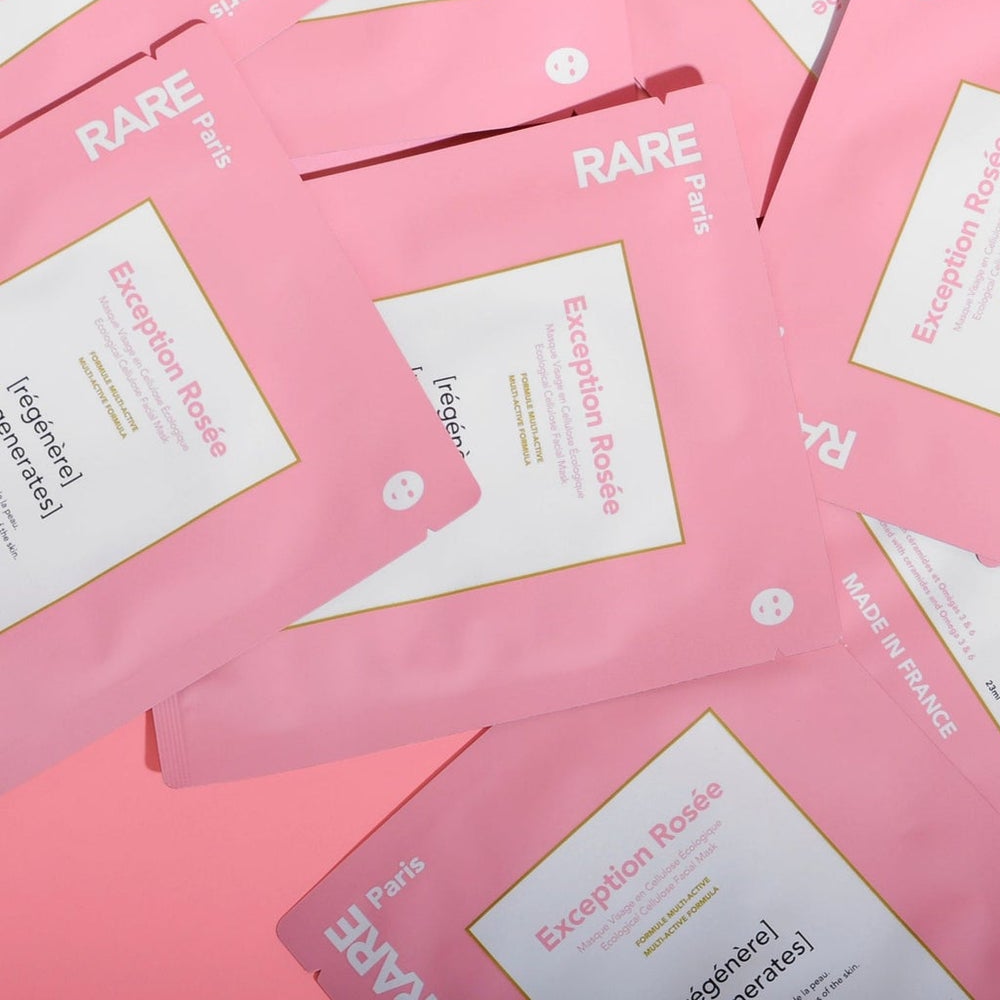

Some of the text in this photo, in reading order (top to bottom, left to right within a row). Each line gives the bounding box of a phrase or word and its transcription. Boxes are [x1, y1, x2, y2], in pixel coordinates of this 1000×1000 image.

[74, 68, 204, 161] RARE
[191, 110, 231, 169] Paris
[572, 122, 702, 188] RARE
[683, 172, 713, 235] Paris
[910, 219, 980, 344] Exception
[77, 356, 127, 439] MULTI-ACTIVE FORMULA
[107, 260, 227, 458] Exception Rosée
[5, 375, 83, 488] [régénère]
[562, 294, 623, 515] Exception Rosée
[842, 573, 957, 739] MADE IN FRANCE
[365, 856, 425, 909] Paris
[533, 782, 723, 952] Exception Rosée
[635, 876, 711, 947] FORMULE MULTI-ACTIVE
[643, 886, 719, 957] MULTI-ACTIVE FORMULA
